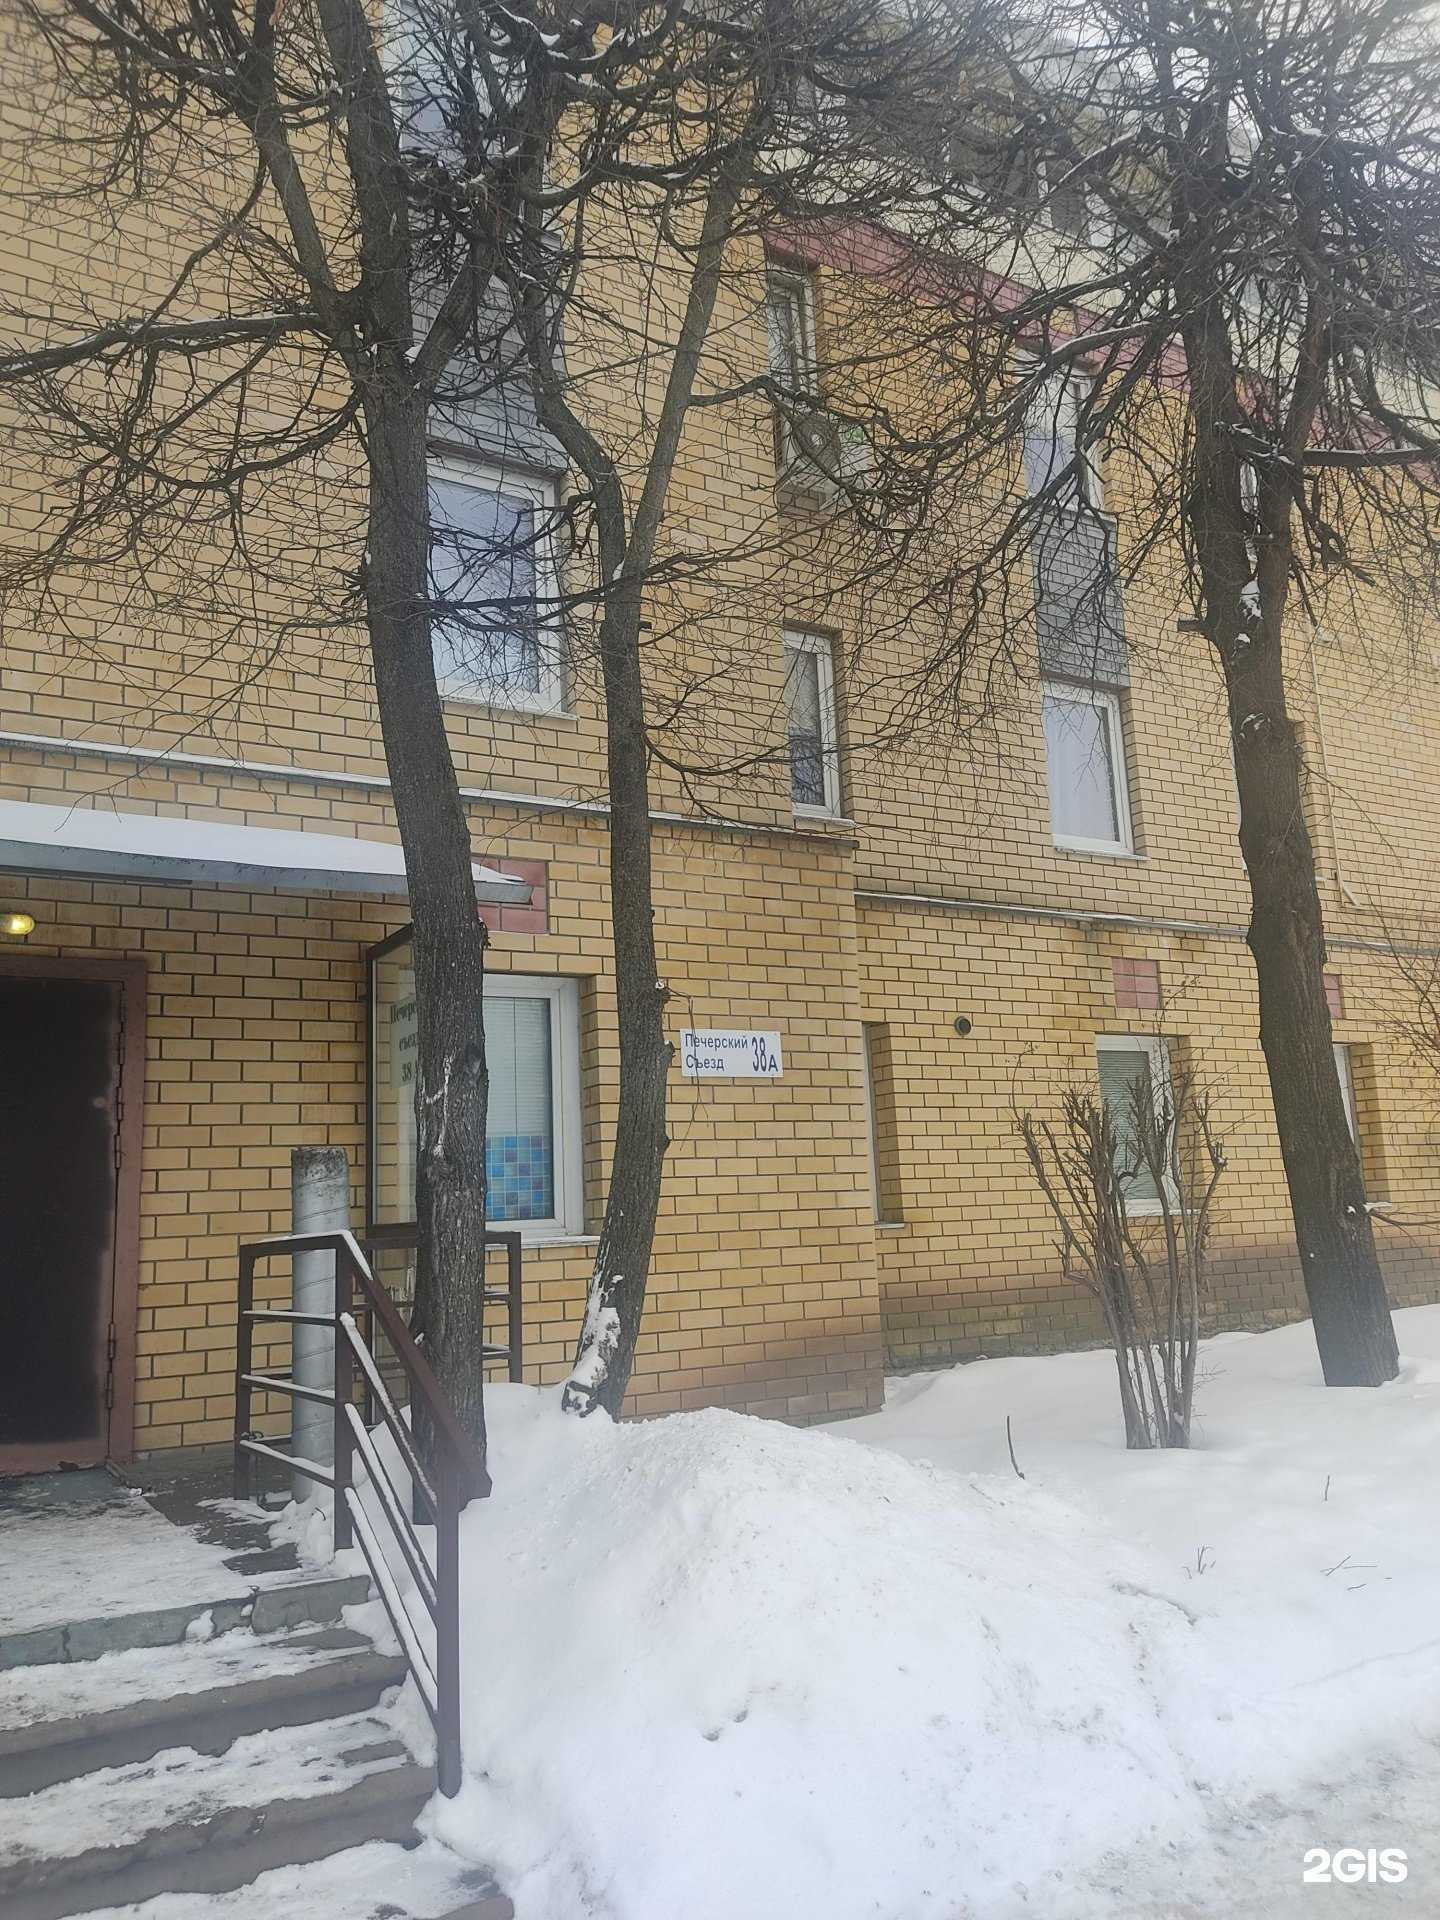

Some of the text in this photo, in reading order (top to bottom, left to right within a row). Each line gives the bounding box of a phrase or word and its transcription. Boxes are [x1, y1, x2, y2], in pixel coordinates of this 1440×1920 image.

[685, 1033, 748, 1051] Печерский
[685, 1054, 724, 1071] Съезд
[751, 1036, 779, 1072] 38А
